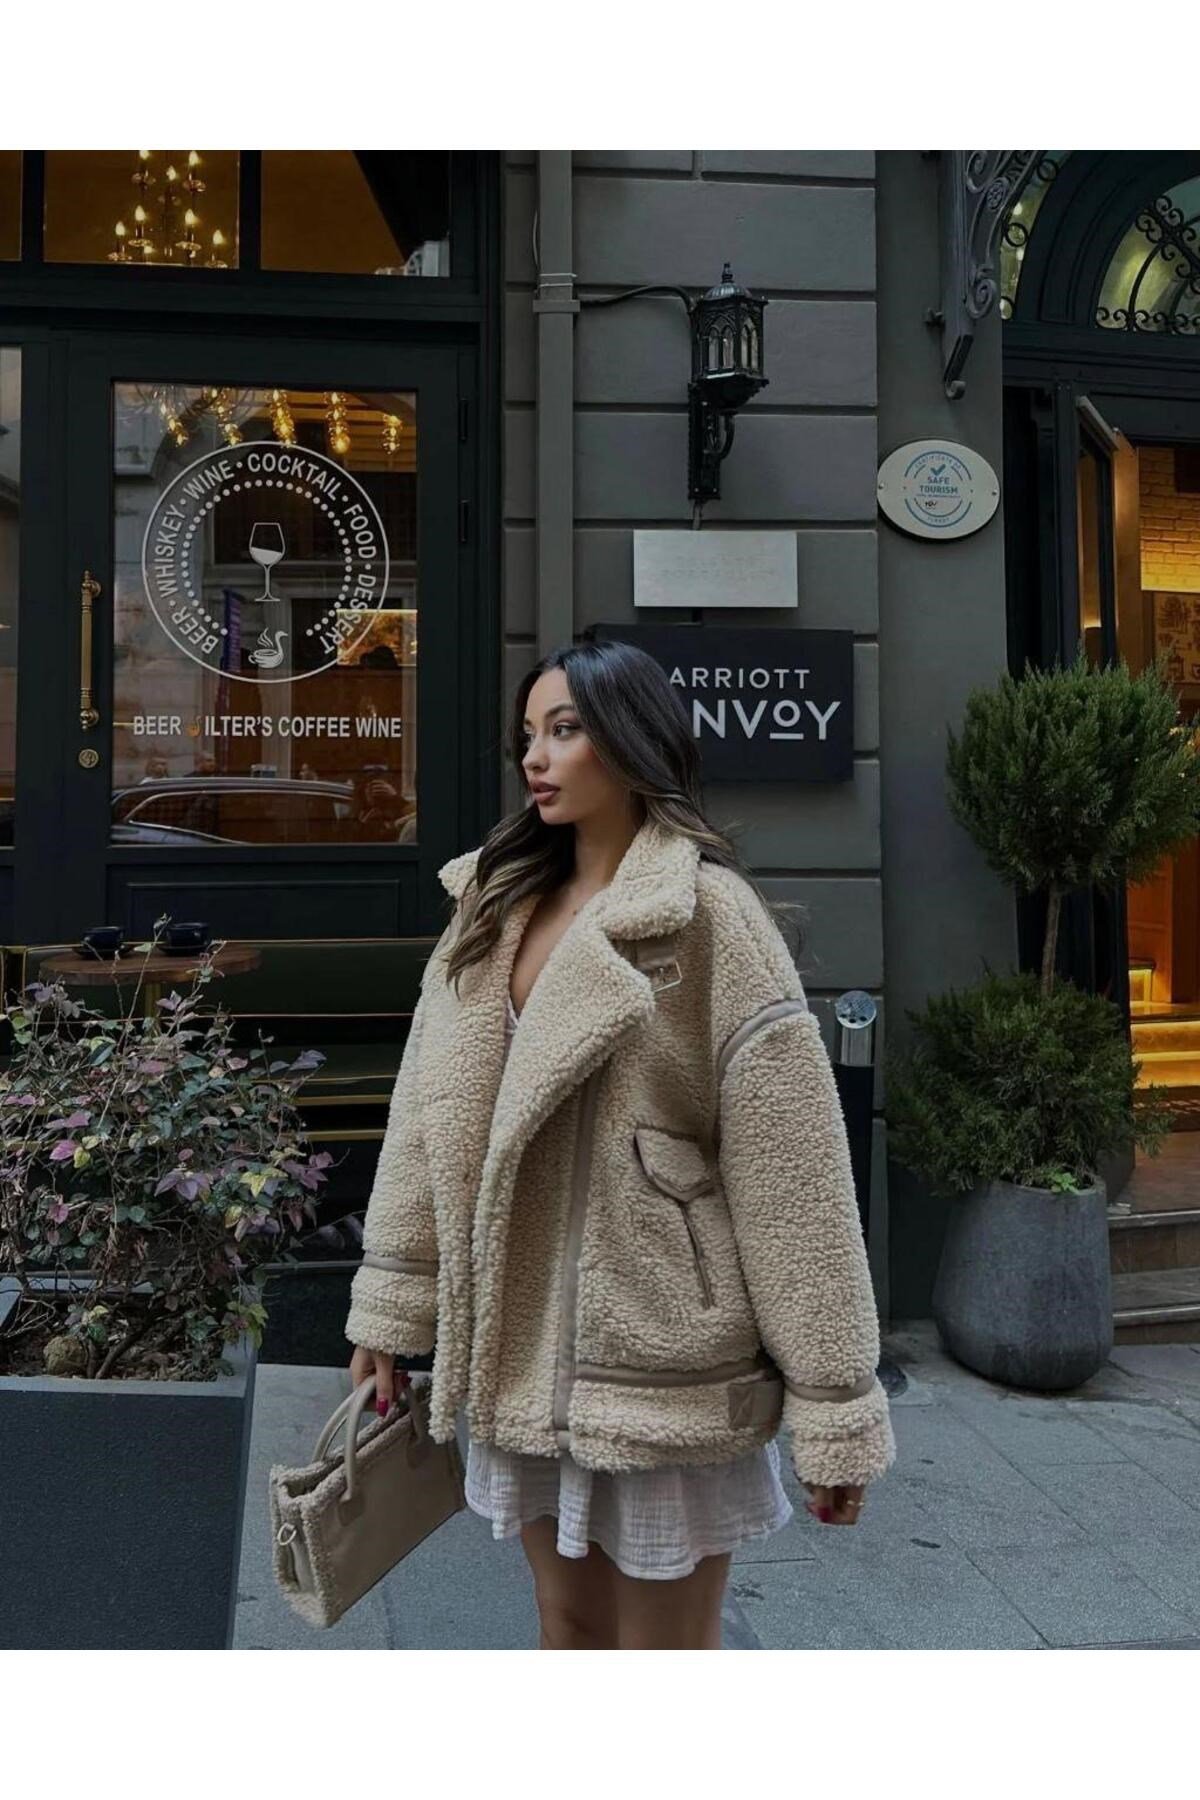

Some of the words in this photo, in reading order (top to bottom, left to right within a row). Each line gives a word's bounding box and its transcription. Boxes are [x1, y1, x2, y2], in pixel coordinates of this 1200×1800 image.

[183, 459, 235, 501] WINE
[247, 452, 344, 501] COCKTAIL
[919, 485, 958, 494] TOURISM
[927, 476, 950, 485] SAFE
[154, 504, 187, 599] WHISKEY
[343, 503, 377, 560] FOOD
[170, 606, 220, 655] BEER
[319, 573, 377, 655] DESSERT
[669, 666, 810, 689] ARRIOTT
[133, 715, 182, 736] BEER
[278, 716, 350, 738] COFFEE
[692, 699, 841, 741] NVOY
